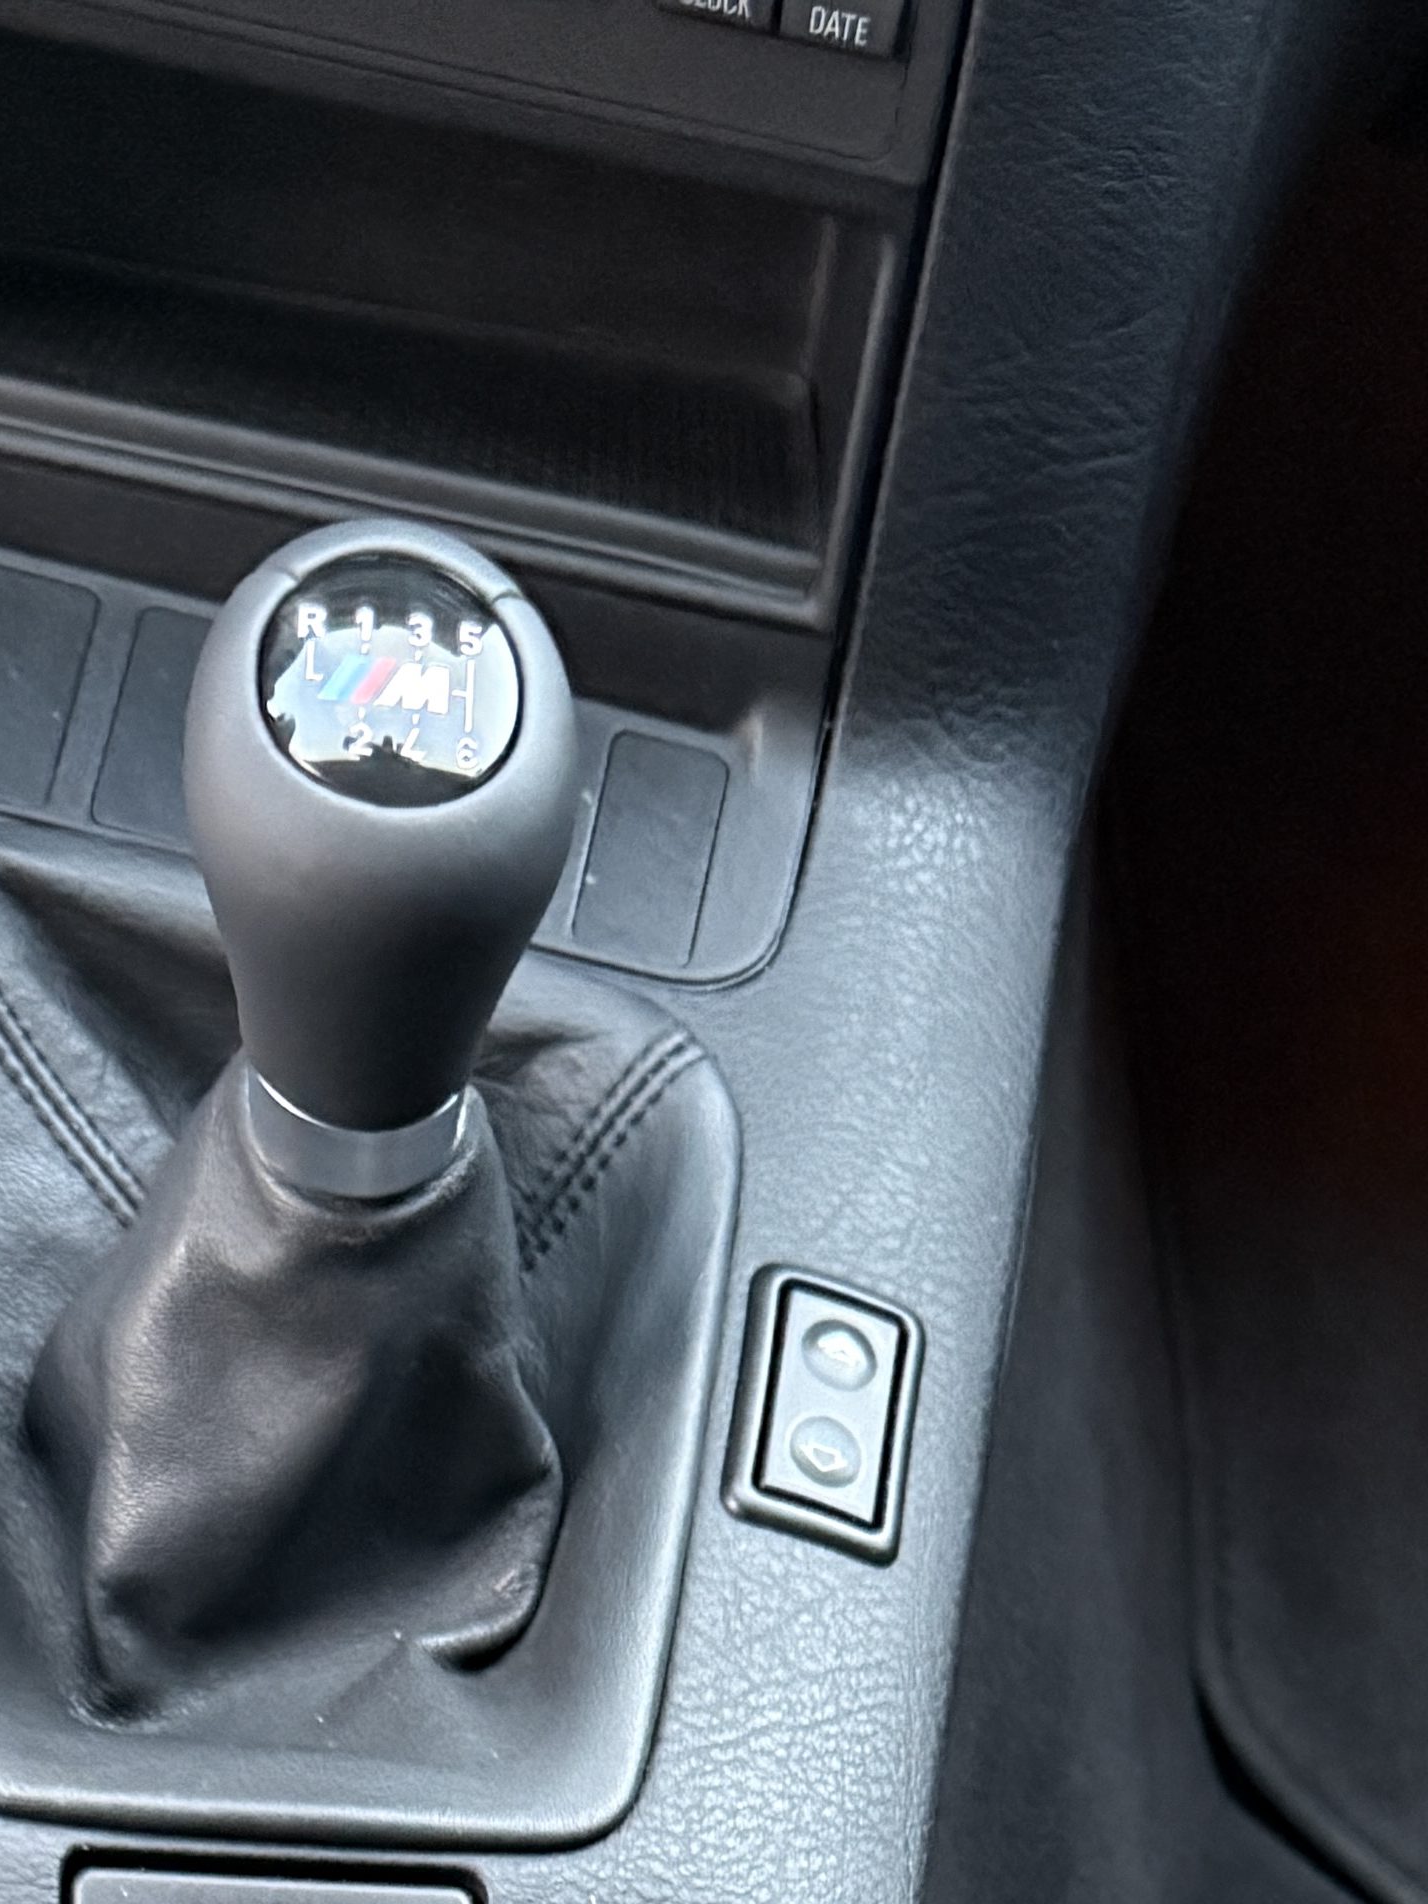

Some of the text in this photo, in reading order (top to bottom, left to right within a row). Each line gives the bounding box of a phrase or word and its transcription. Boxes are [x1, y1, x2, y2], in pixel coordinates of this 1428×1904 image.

[809, 5, 870, 47] DATE
[297, 605, 483, 655] R 1 3 5
[373, 661, 450, 715] M
[348, 723, 373, 756] 2
[456, 736, 479, 769] 6
